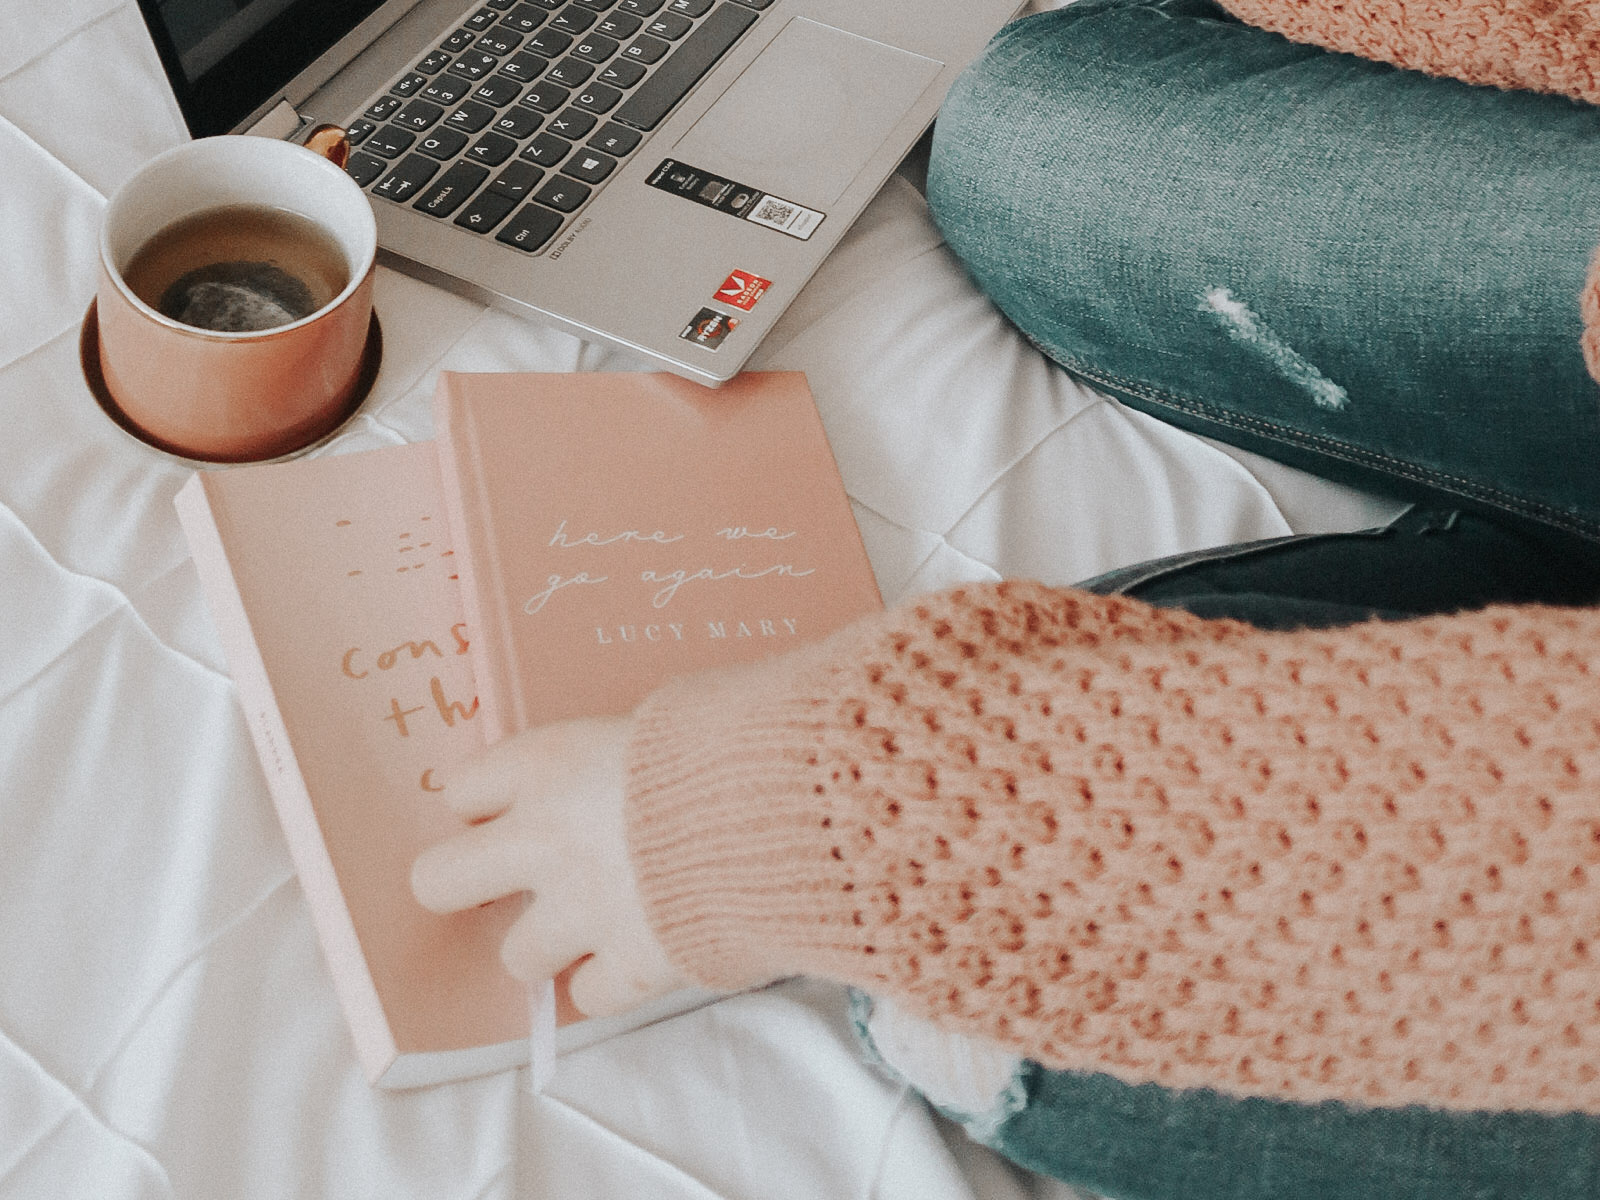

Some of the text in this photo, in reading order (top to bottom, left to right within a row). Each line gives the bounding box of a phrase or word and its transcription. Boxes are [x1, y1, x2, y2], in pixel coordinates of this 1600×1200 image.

[674, 0, 690, 9] M
[601, 22, 616, 30] H
[652, 23, 666, 32] N
[578, 45, 592, 53] G
[628, 47, 642, 55] B
[505, 64, 520, 72] R
[552, 69, 563, 78] F
[478, 88, 494, 96] E
[526, 94, 540, 103] D
[580, 94, 594, 103] C
[451, 110, 468, 121] W
[500, 120, 514, 128] S
[554, 120, 569, 129] X
[424, 139, 440, 148] Q
[606, 138, 618, 147] Alt
[474, 147, 488, 155] A
[526, 146, 542, 156] Z
[428, 187, 453, 208] CapsLk
[552, 193, 564, 202] Fn
[515, 230, 530, 241] Ctrl
[737, 279, 759, 304] RADEON
[697, 315, 723, 341] RYZEN
[549, 520, 796, 547] here we
[524, 563, 816, 615] go again
[596, 617, 797, 645] LUCY MARY
